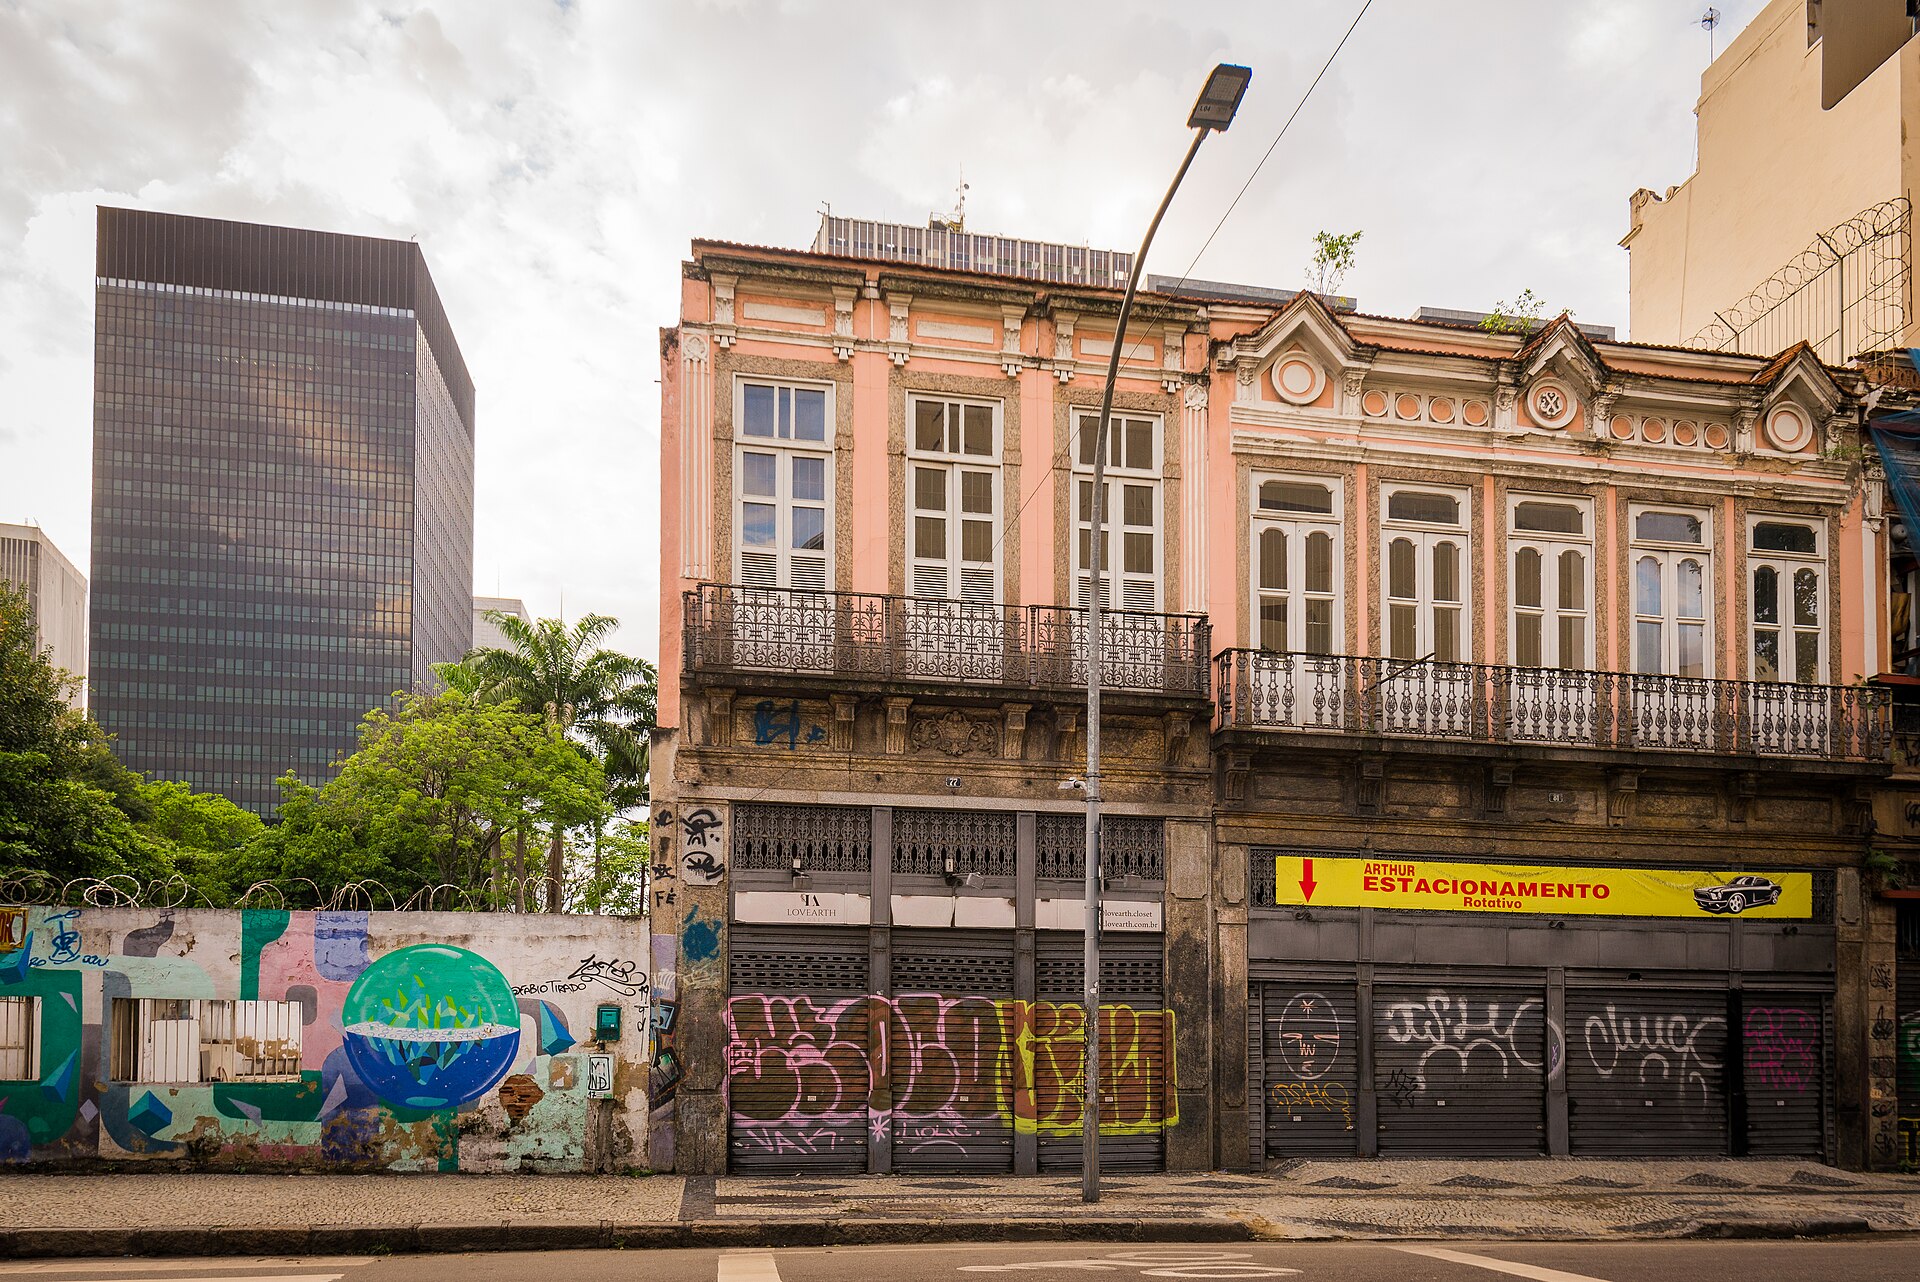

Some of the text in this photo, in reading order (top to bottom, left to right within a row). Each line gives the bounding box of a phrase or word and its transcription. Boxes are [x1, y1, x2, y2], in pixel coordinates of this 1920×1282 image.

[1364, 863, 1415, 877] ARTHUR
[1363, 876, 1610, 899] ESTACIONAMENTO
[1463, 897, 1522, 909] Rotativo
[787, 908, 836, 917] LOVEARTH
[545, 979, 587, 994] TIRADO
